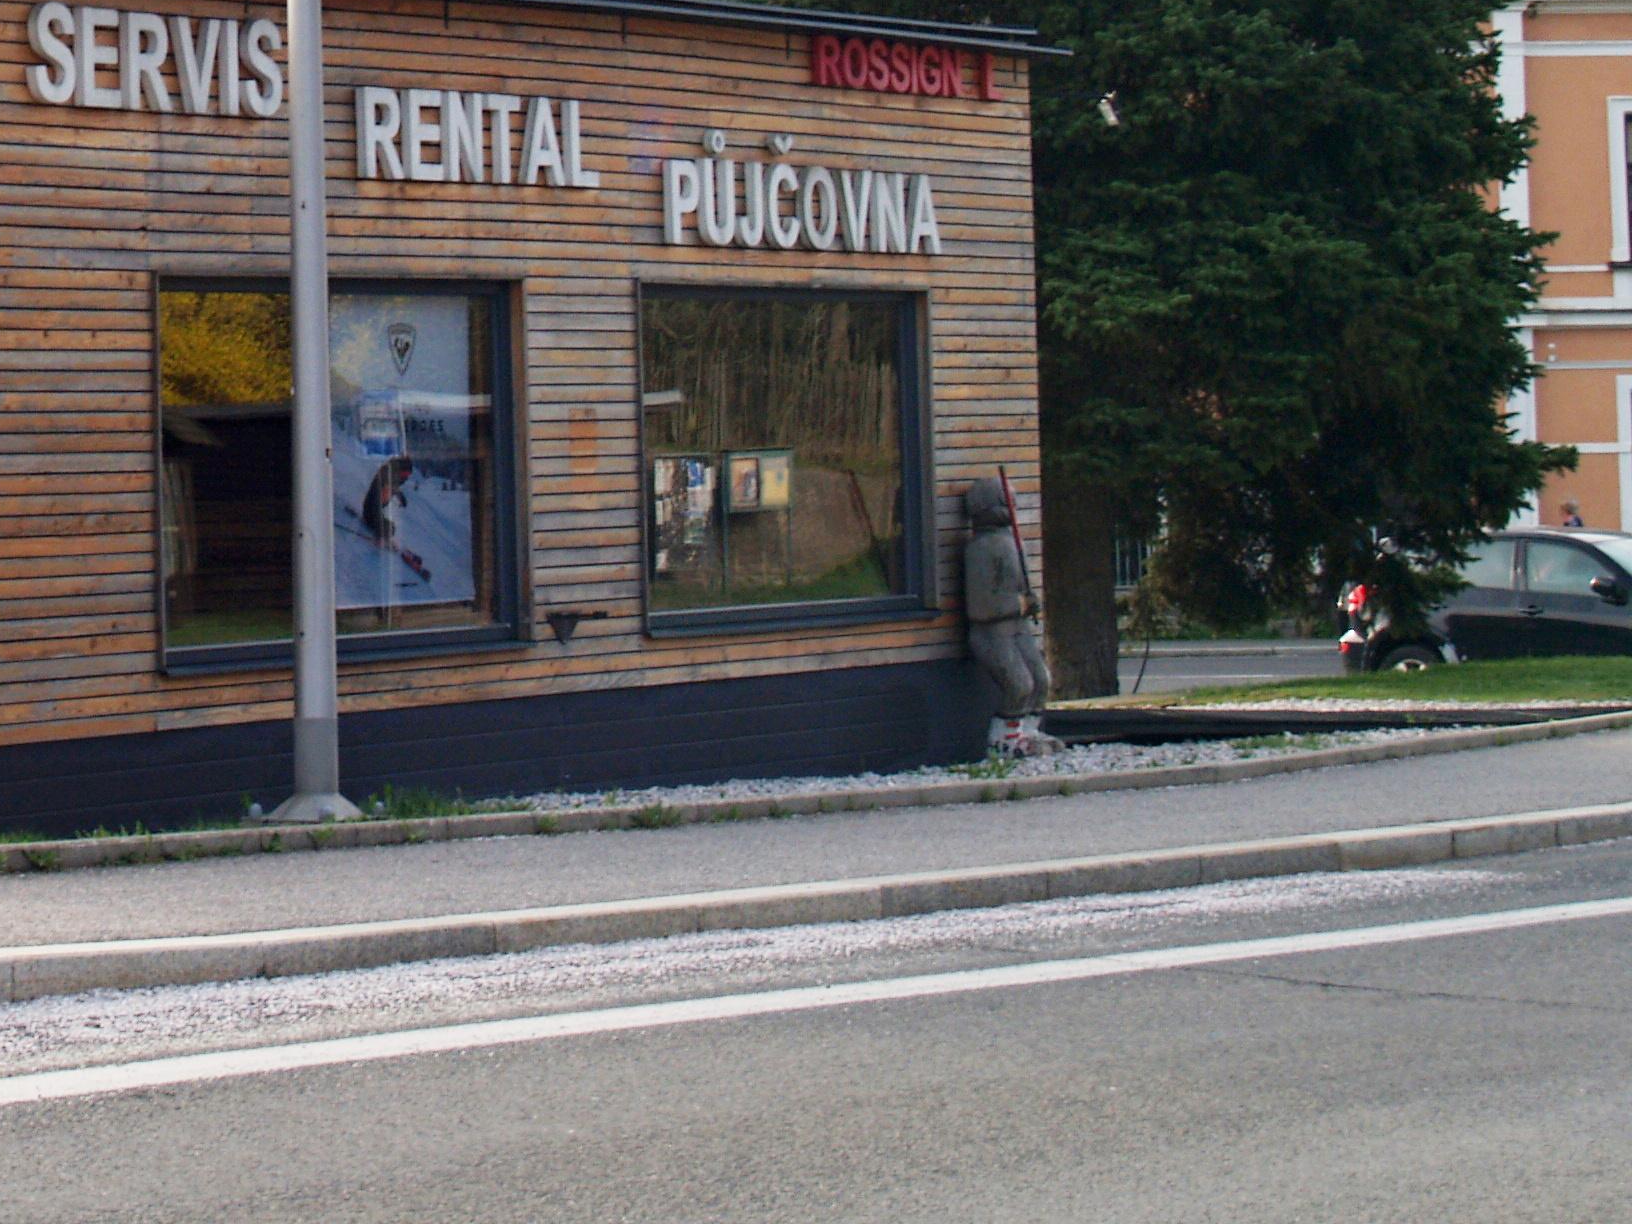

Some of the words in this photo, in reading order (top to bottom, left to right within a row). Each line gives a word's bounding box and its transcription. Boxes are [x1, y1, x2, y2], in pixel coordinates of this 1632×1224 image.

[25, 1, 284, 118] SERVIS
[812, 34, 1003, 102] ROSSIGNL
[354, 85, 600, 189] RENTAL
